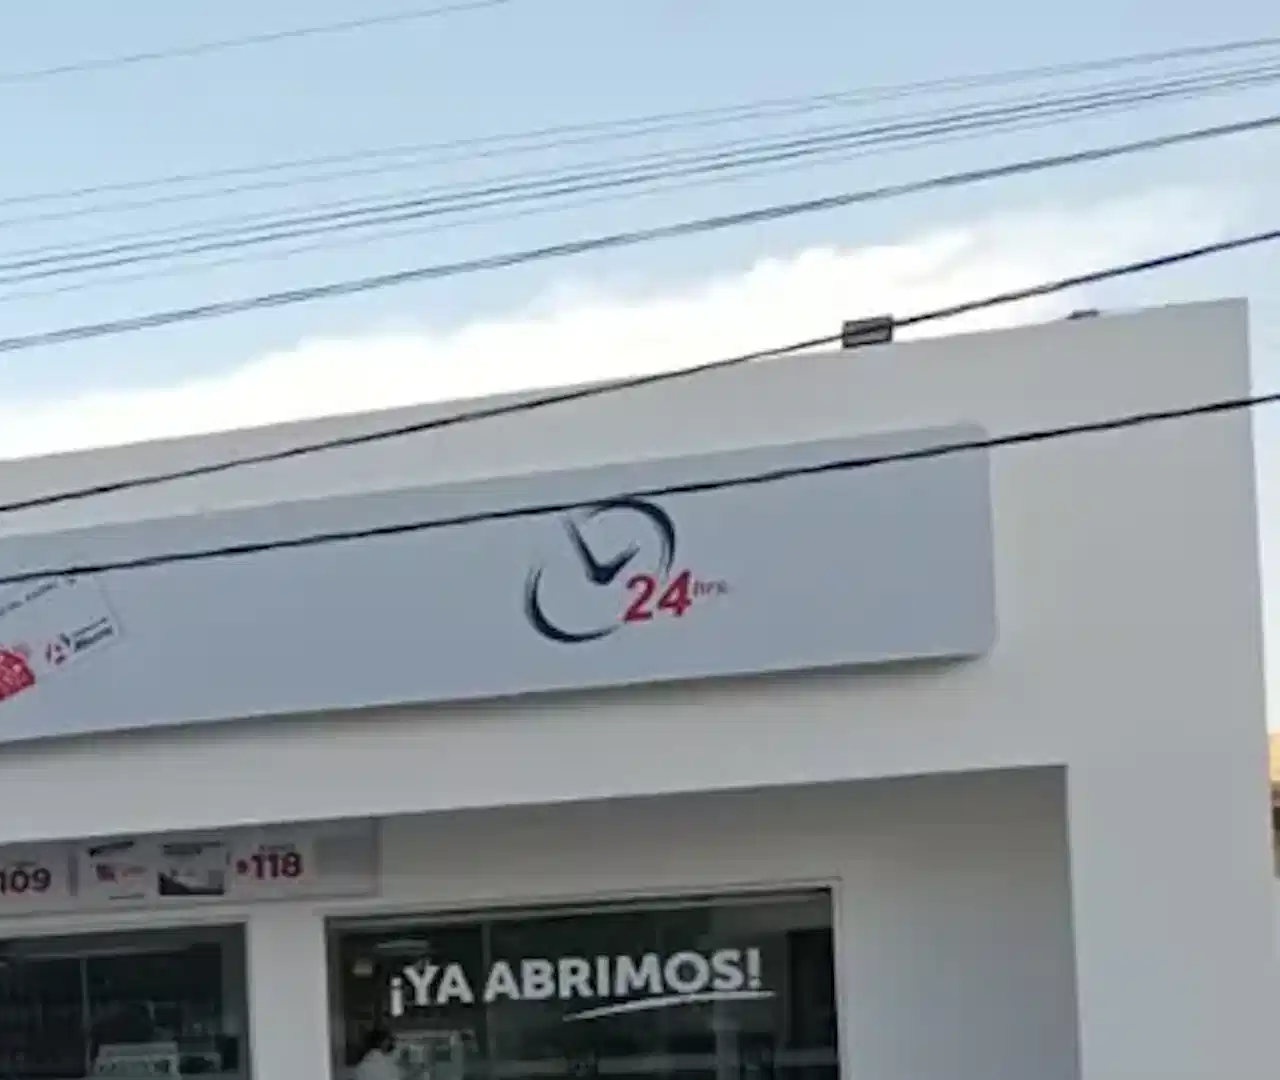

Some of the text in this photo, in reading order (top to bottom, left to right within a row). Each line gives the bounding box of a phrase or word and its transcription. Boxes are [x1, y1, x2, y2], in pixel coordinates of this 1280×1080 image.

[624, 569, 693, 623] 24
[391, 948, 763, 1017] ¡YA ABRIMOS!
